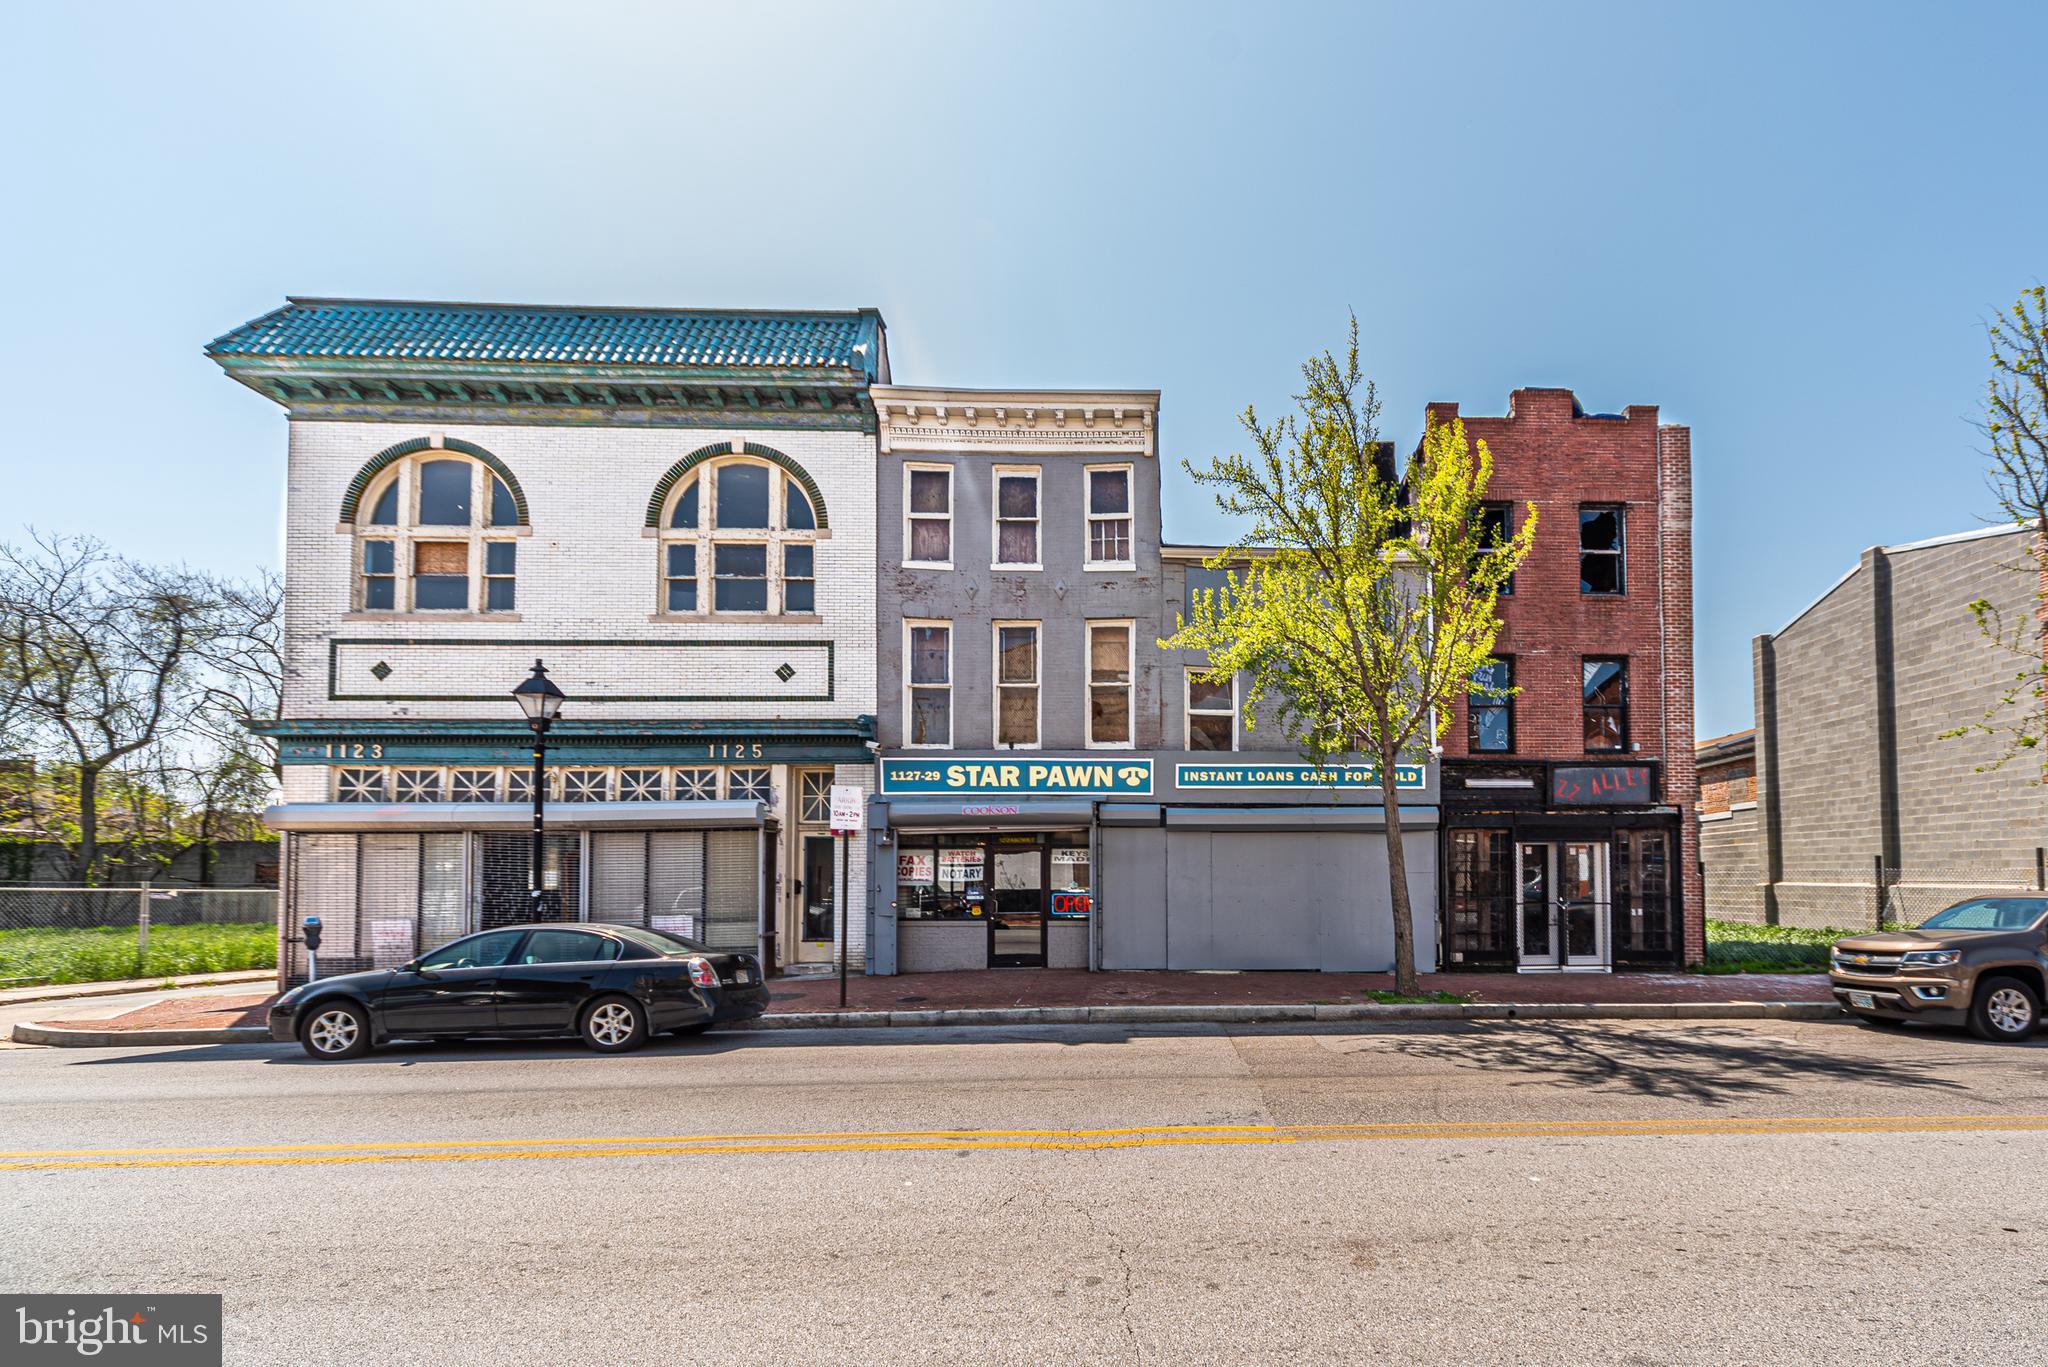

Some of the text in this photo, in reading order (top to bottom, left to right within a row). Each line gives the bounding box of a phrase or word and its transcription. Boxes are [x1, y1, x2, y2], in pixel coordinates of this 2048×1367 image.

[325, 743, 383, 759] 1123
[708, 743, 763, 759] 1125
[889, 764, 1114, 788] 1127-29 STAR PAWN
[1183, 771, 1243, 782] INSTANT
[1247, 771, 1295, 782] LOANS
[1344, 771, 1373, 782] FOR
[962, 804, 1018, 816] COOKSON
[899, 855, 926, 866] FAX
[941, 868, 981, 879] NOTARY
